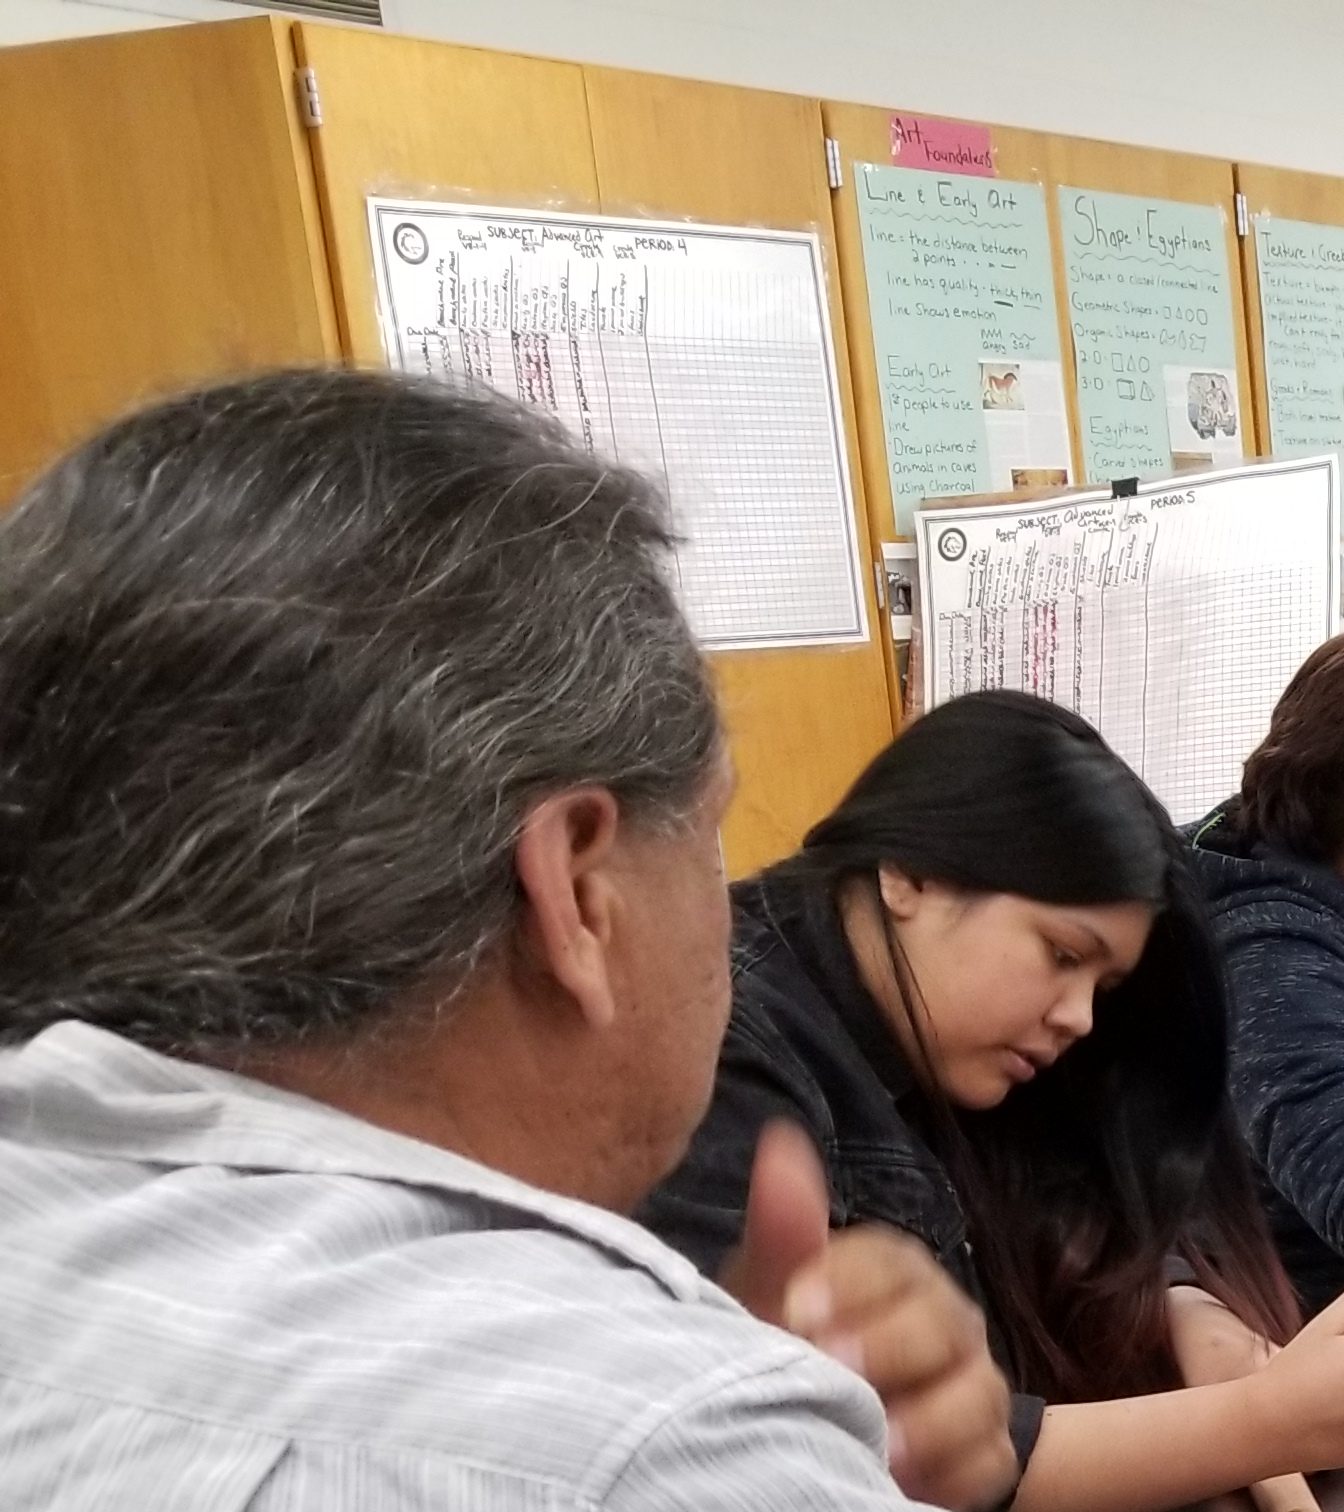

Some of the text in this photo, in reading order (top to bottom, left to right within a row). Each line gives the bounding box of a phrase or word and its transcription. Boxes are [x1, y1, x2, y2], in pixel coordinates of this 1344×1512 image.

[864, 171, 906, 203] Line
[937, 181, 978, 217] Early
[988, 189, 1018, 211] Art
[1074, 195, 1132, 251] Shape
[1147, 209, 1212, 259] Egyptians
[909, 230, 932, 247] the
[933, 232, 978, 253] distance
[982, 237, 1028, 258] between
[1261, 231, 1307, 260] Texture
[887, 272, 910, 287] line
[914, 274, 935, 289] has
[939, 278, 979, 297] quality
[1021, 287, 1042, 302] thin
[889, 298, 911, 315] line
[953, 306, 997, 320] emotion
[887, 355, 925, 386] Early
[903, 399, 936, 417] people
[940, 398, 950, 409] to
[954, 401, 975, 411] use
[893, 437, 923, 456] Drew
[925, 442, 964, 456] pictures
[937, 461, 948, 472] in
[1185, 490, 1196, 503] 5
